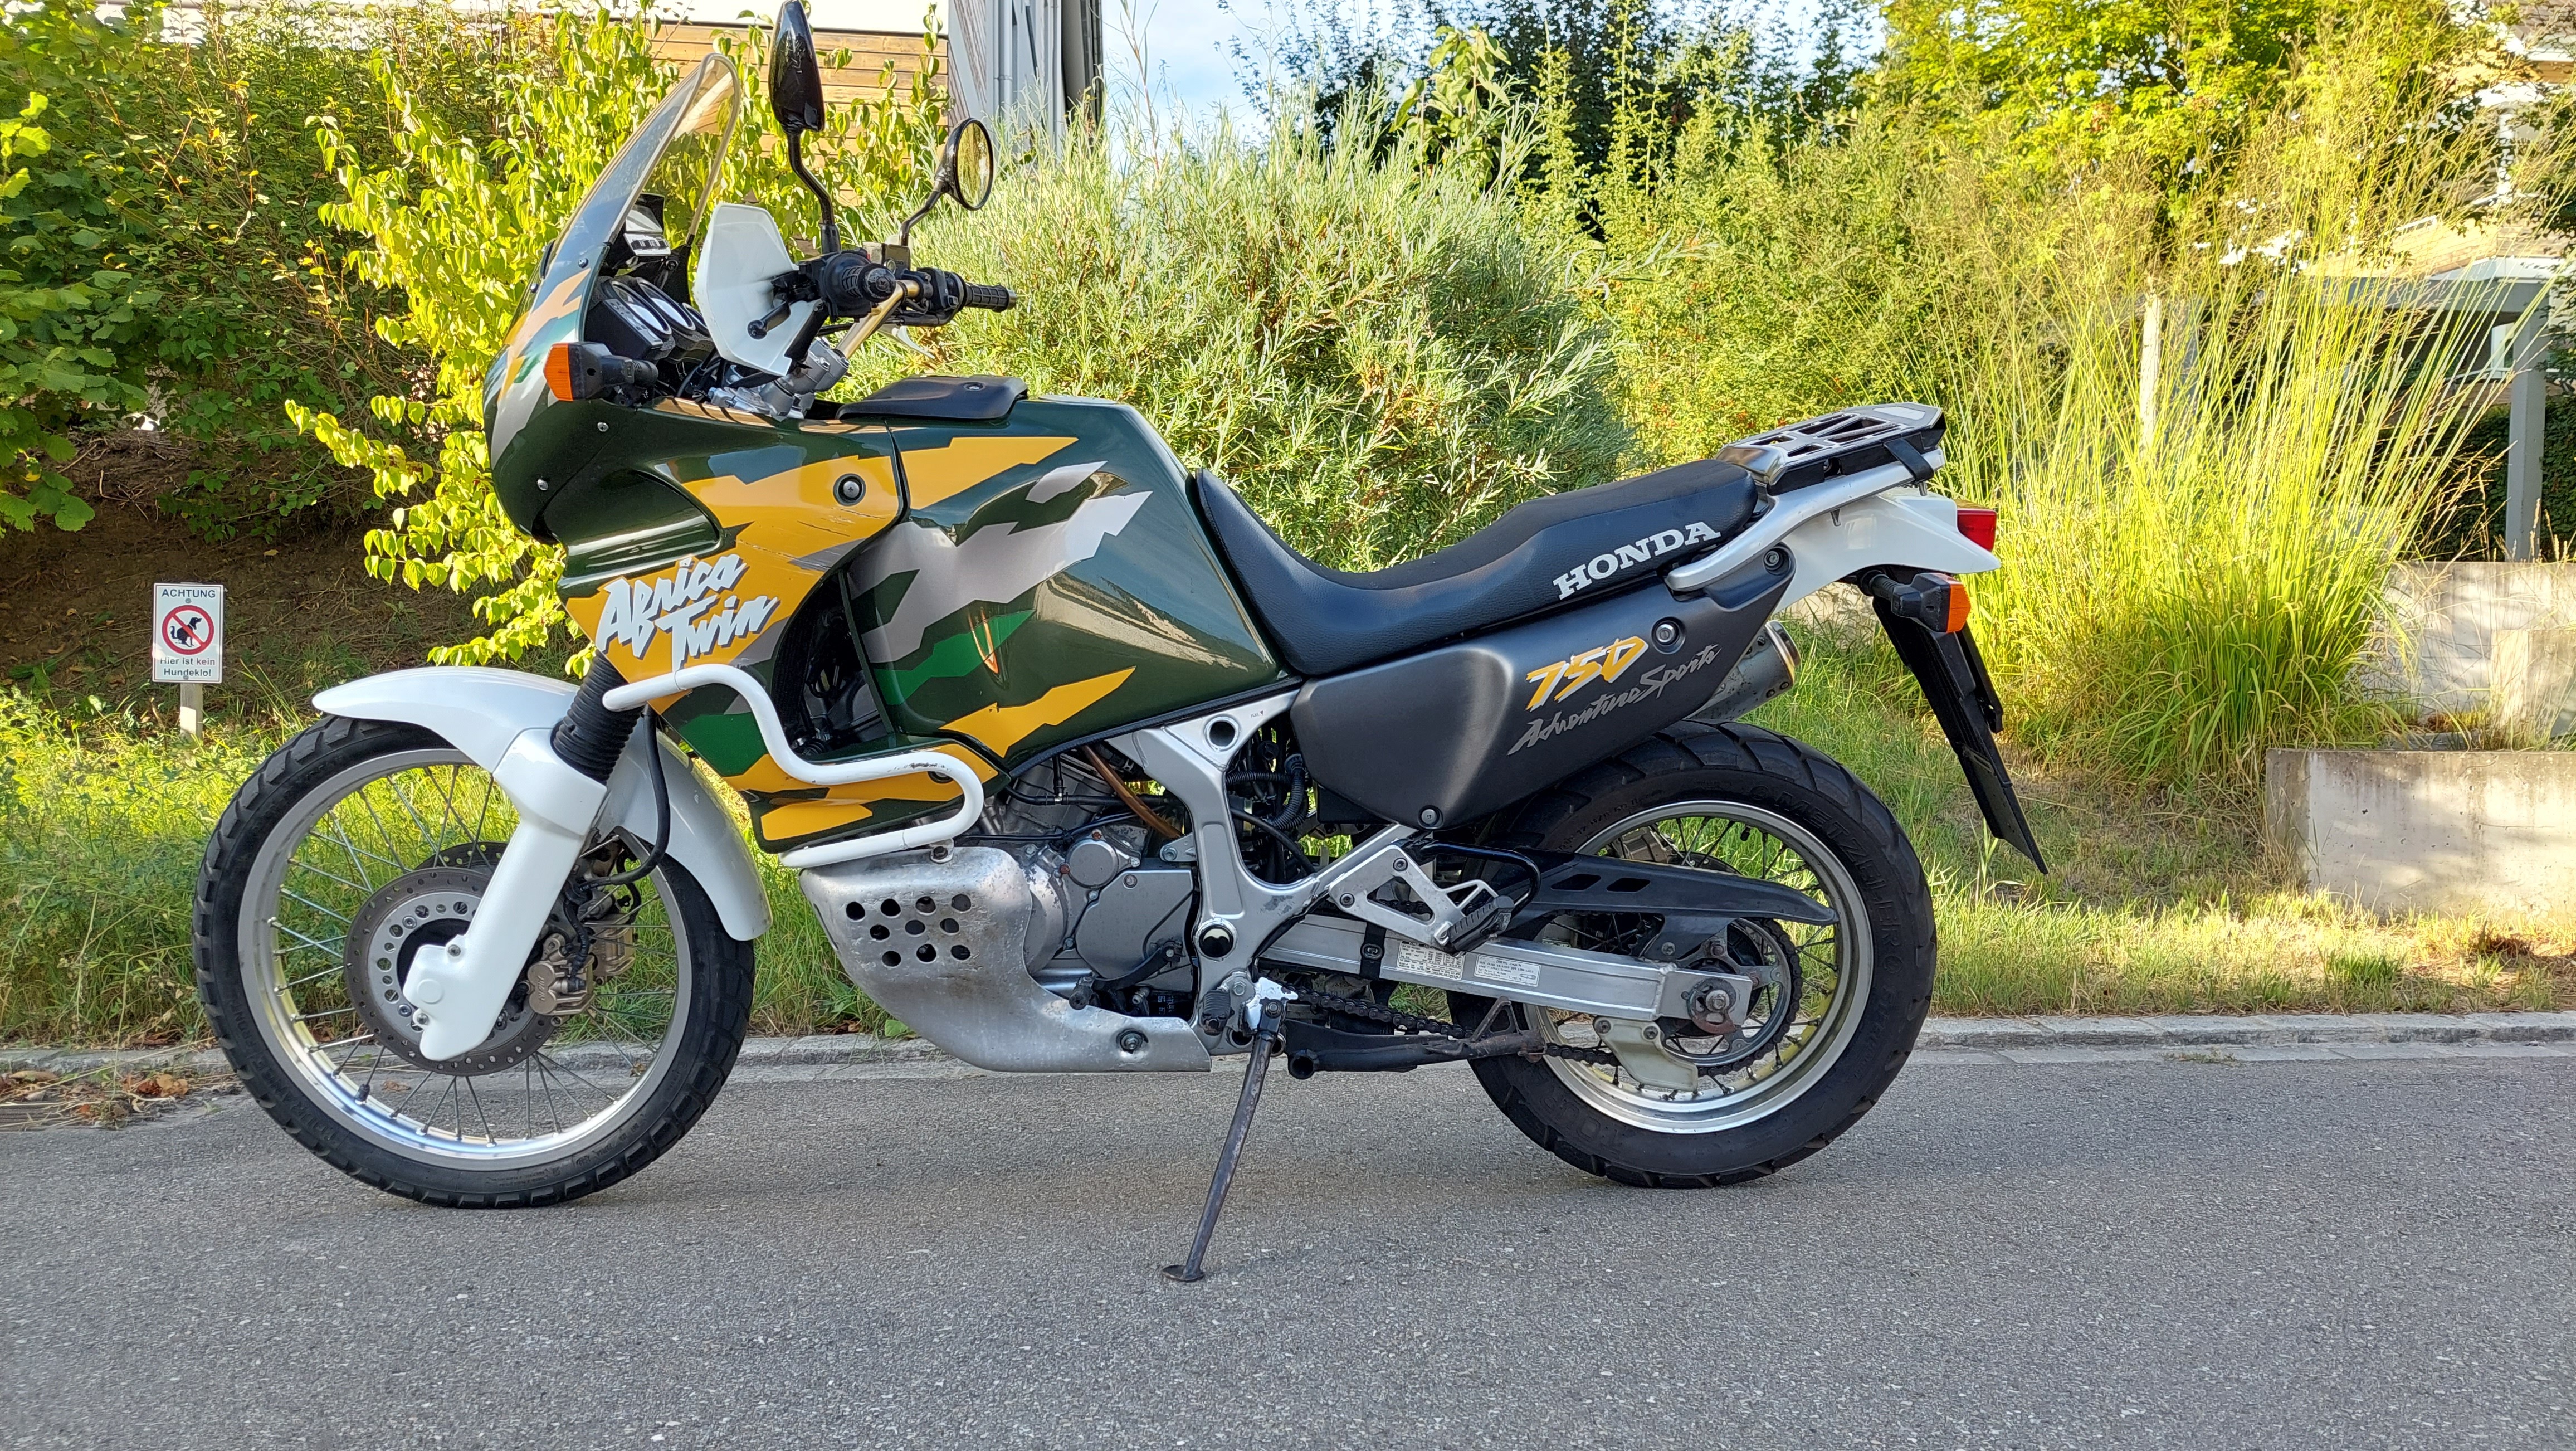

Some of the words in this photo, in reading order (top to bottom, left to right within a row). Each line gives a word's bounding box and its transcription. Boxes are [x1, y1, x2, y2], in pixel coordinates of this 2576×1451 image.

[161, 588, 216, 598] ACHTUNG
[1553, 522, 1721, 600] HONDA
[594, 553, 750, 660] Africa
[655, 594, 781, 673] Twin
[160, 657, 180, 665] Hier
[182, 657, 194, 665] ist
[196, 658, 216, 666] kein
[163, 668, 212, 677] Hundeklo!
[1525, 636, 1649, 713] 750
